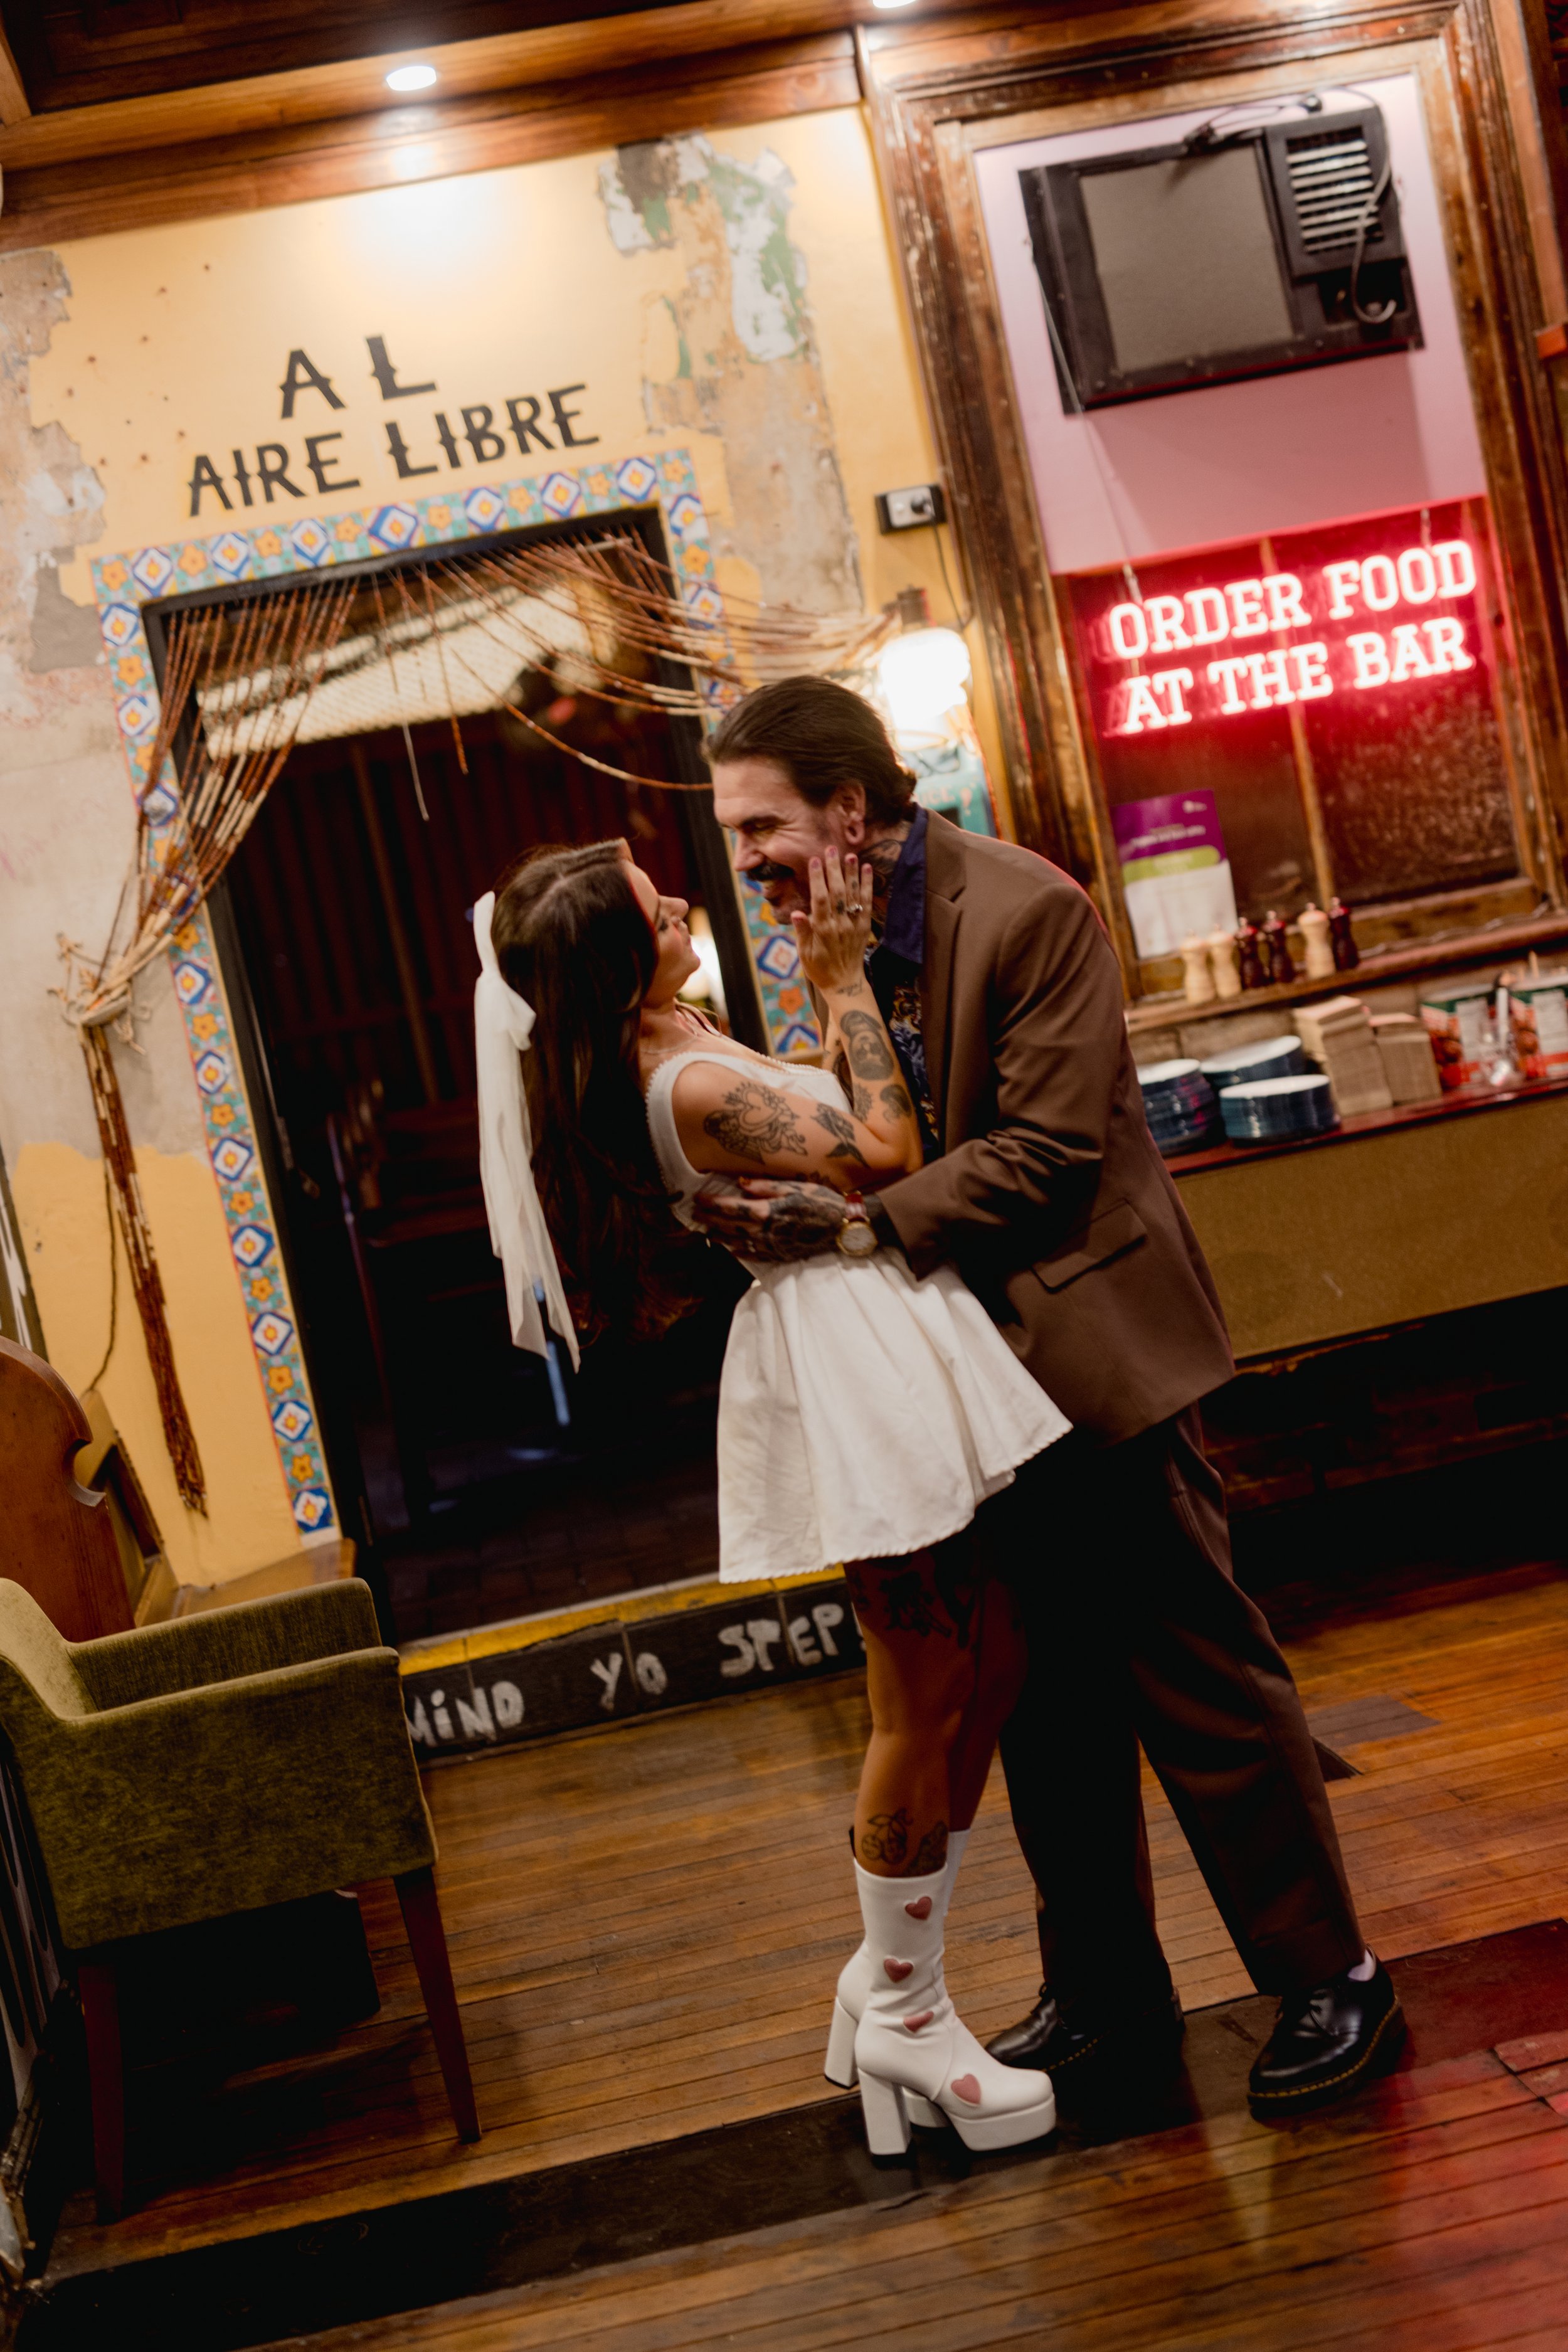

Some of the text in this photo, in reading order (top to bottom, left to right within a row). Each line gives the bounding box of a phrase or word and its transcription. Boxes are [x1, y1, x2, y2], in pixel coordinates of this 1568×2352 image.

[188, 383, 600, 516] AIRE LIBRE
[1109, 539, 1476, 659] ORDER FOOD
[1120, 615, 1474, 734] AT THE BAR
